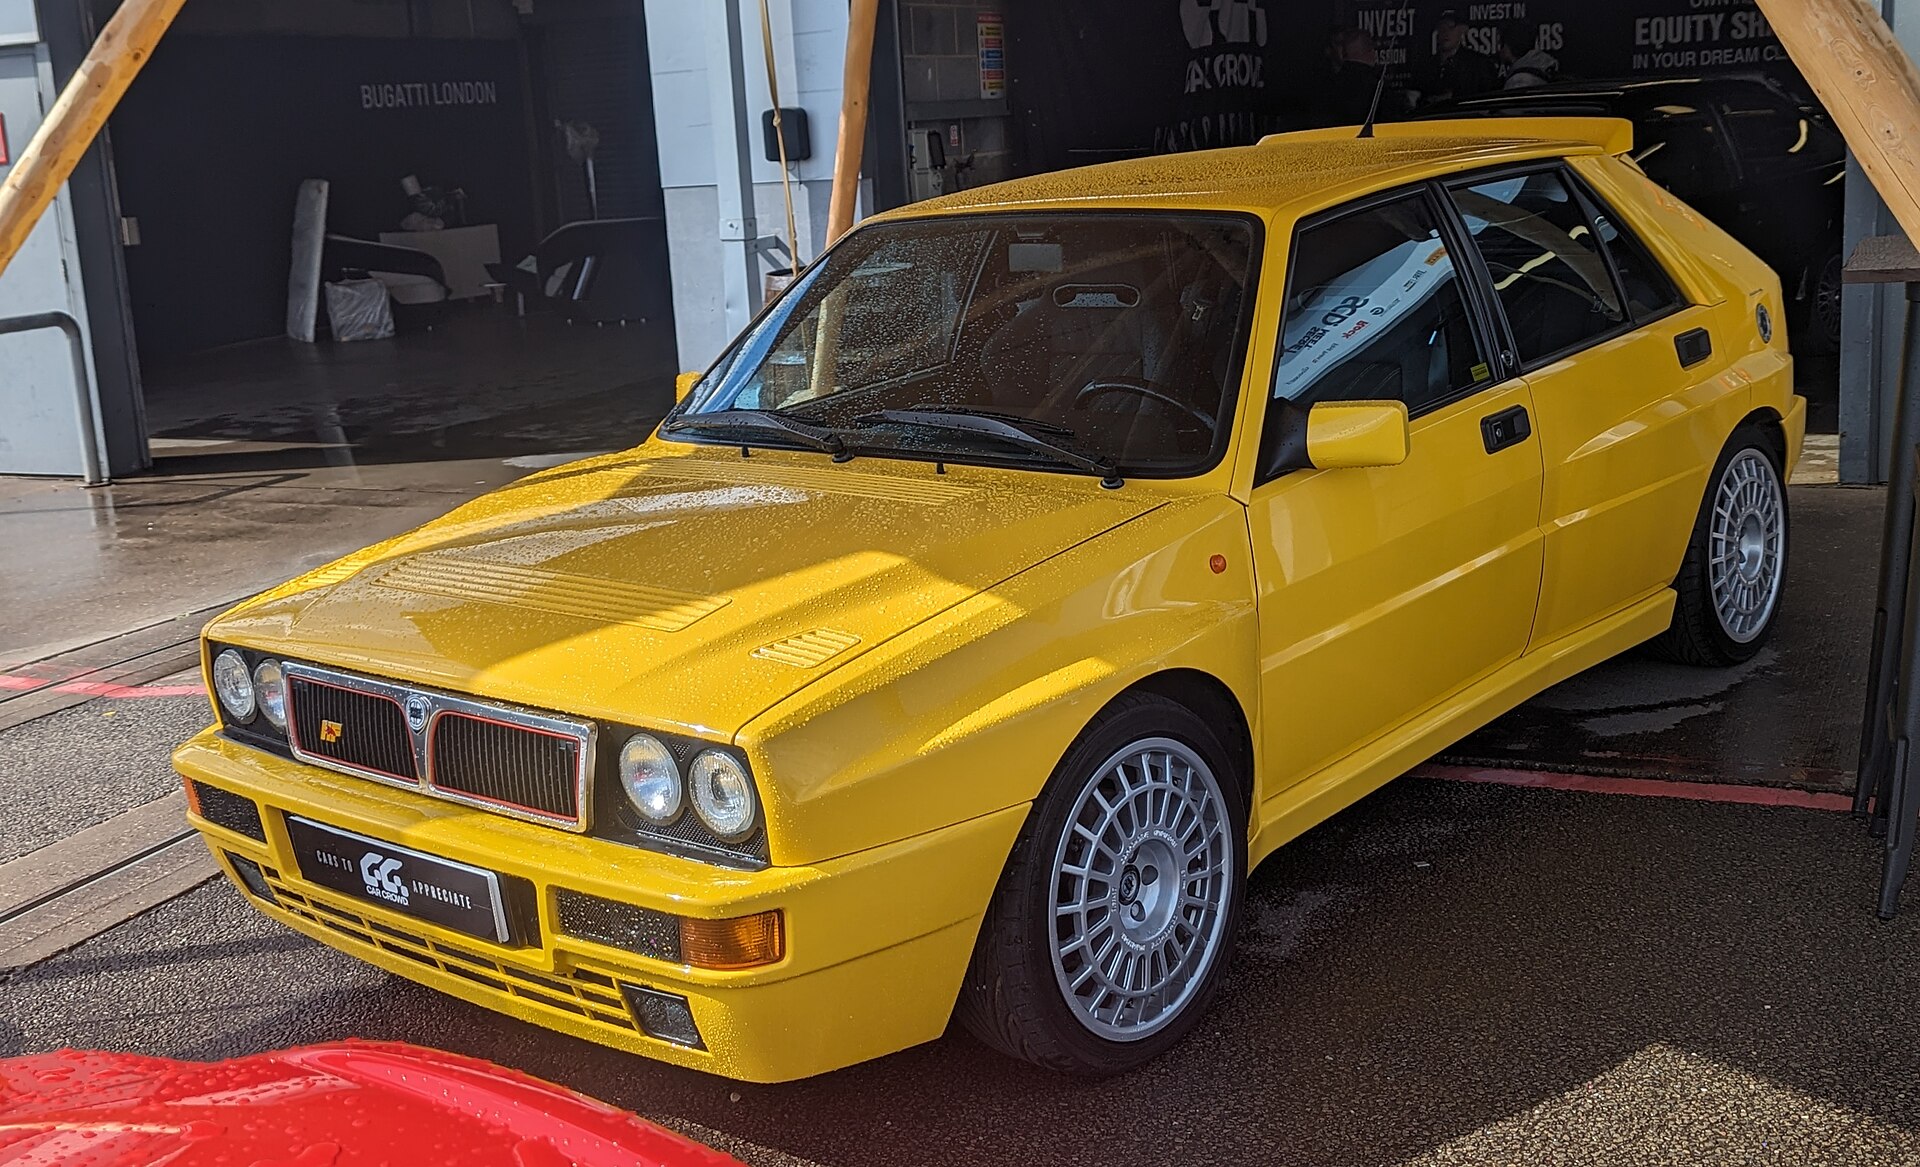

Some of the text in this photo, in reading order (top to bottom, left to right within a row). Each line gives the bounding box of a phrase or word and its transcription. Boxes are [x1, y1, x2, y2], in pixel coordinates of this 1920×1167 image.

[1358, 8, 1416, 37] INVEST
[1470, 2, 1527, 21] INVEST IN
[1635, 13, 1726, 49] EQUITY
[1633, 53, 1648, 69] IN
[1651, 50, 1697, 69] YOUR
[1700, 46, 1760, 66] DREAM
[360, 81, 497, 109] BUGATTI LONDON
[316, 850, 354, 873] CARS TO
[366, 885, 381, 898] CAR
[412, 880, 472, 910] APPRECIATE
